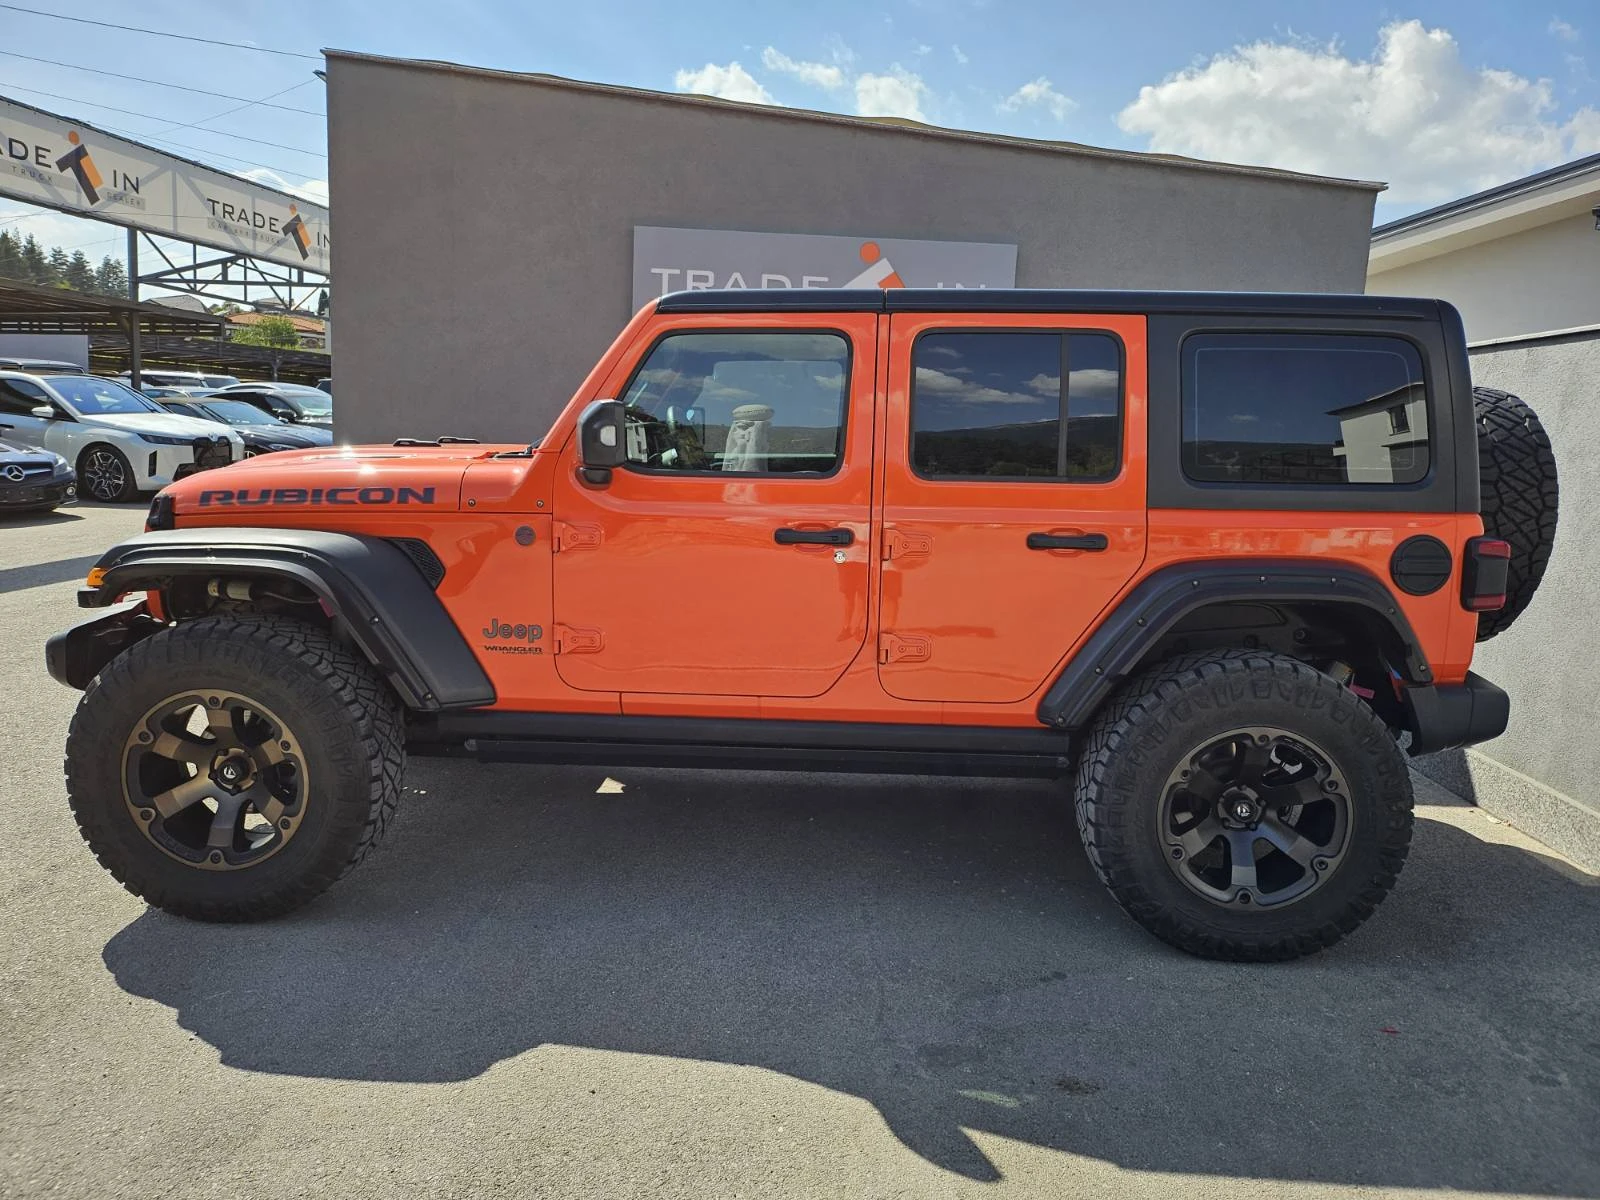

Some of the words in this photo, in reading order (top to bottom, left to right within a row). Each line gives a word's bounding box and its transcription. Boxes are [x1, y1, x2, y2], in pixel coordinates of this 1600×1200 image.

[113, 169, 140, 195] IN
[206, 197, 280, 233] TRADE
[198, 487, 437, 507] RUBICON
[482, 618, 543, 643] Jeep
[484, 645, 543, 653] WRANGLER
